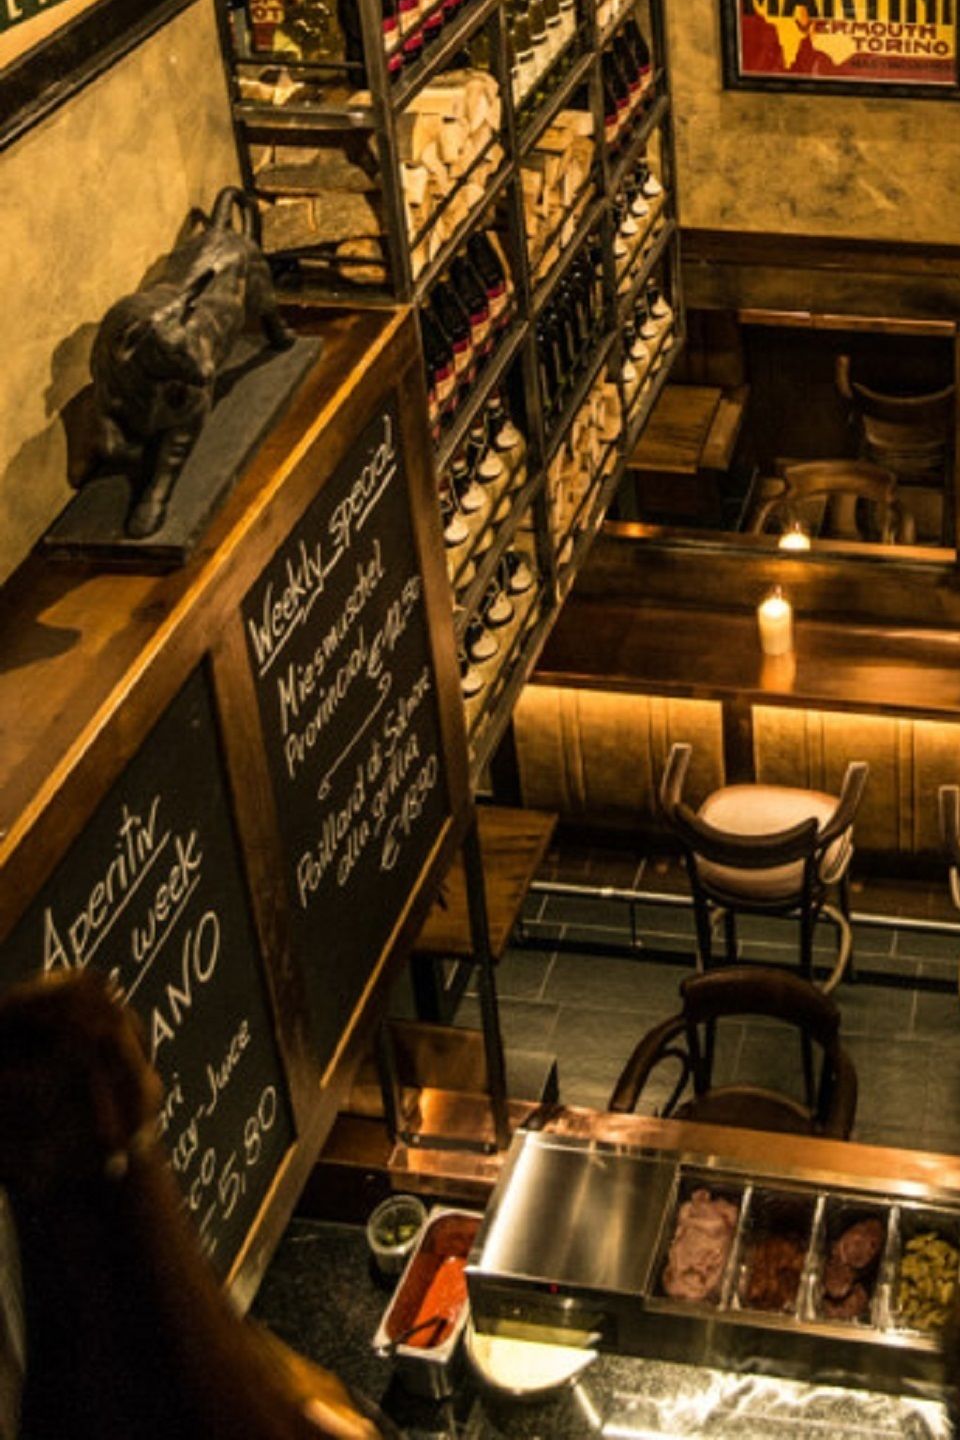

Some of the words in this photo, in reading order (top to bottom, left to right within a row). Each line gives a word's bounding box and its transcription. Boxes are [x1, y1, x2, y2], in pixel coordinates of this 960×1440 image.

[796, 18, 937, 40] VERMOUTH
[852, 36, 949, 56] TORINO
[248, 539, 324, 665] Weekly
[329, 413, 396, 552] special
[43, 795, 162, 973] Aperitiv
[132, 829, 202, 963] week
[151, 910, 221, 1066] ANO
